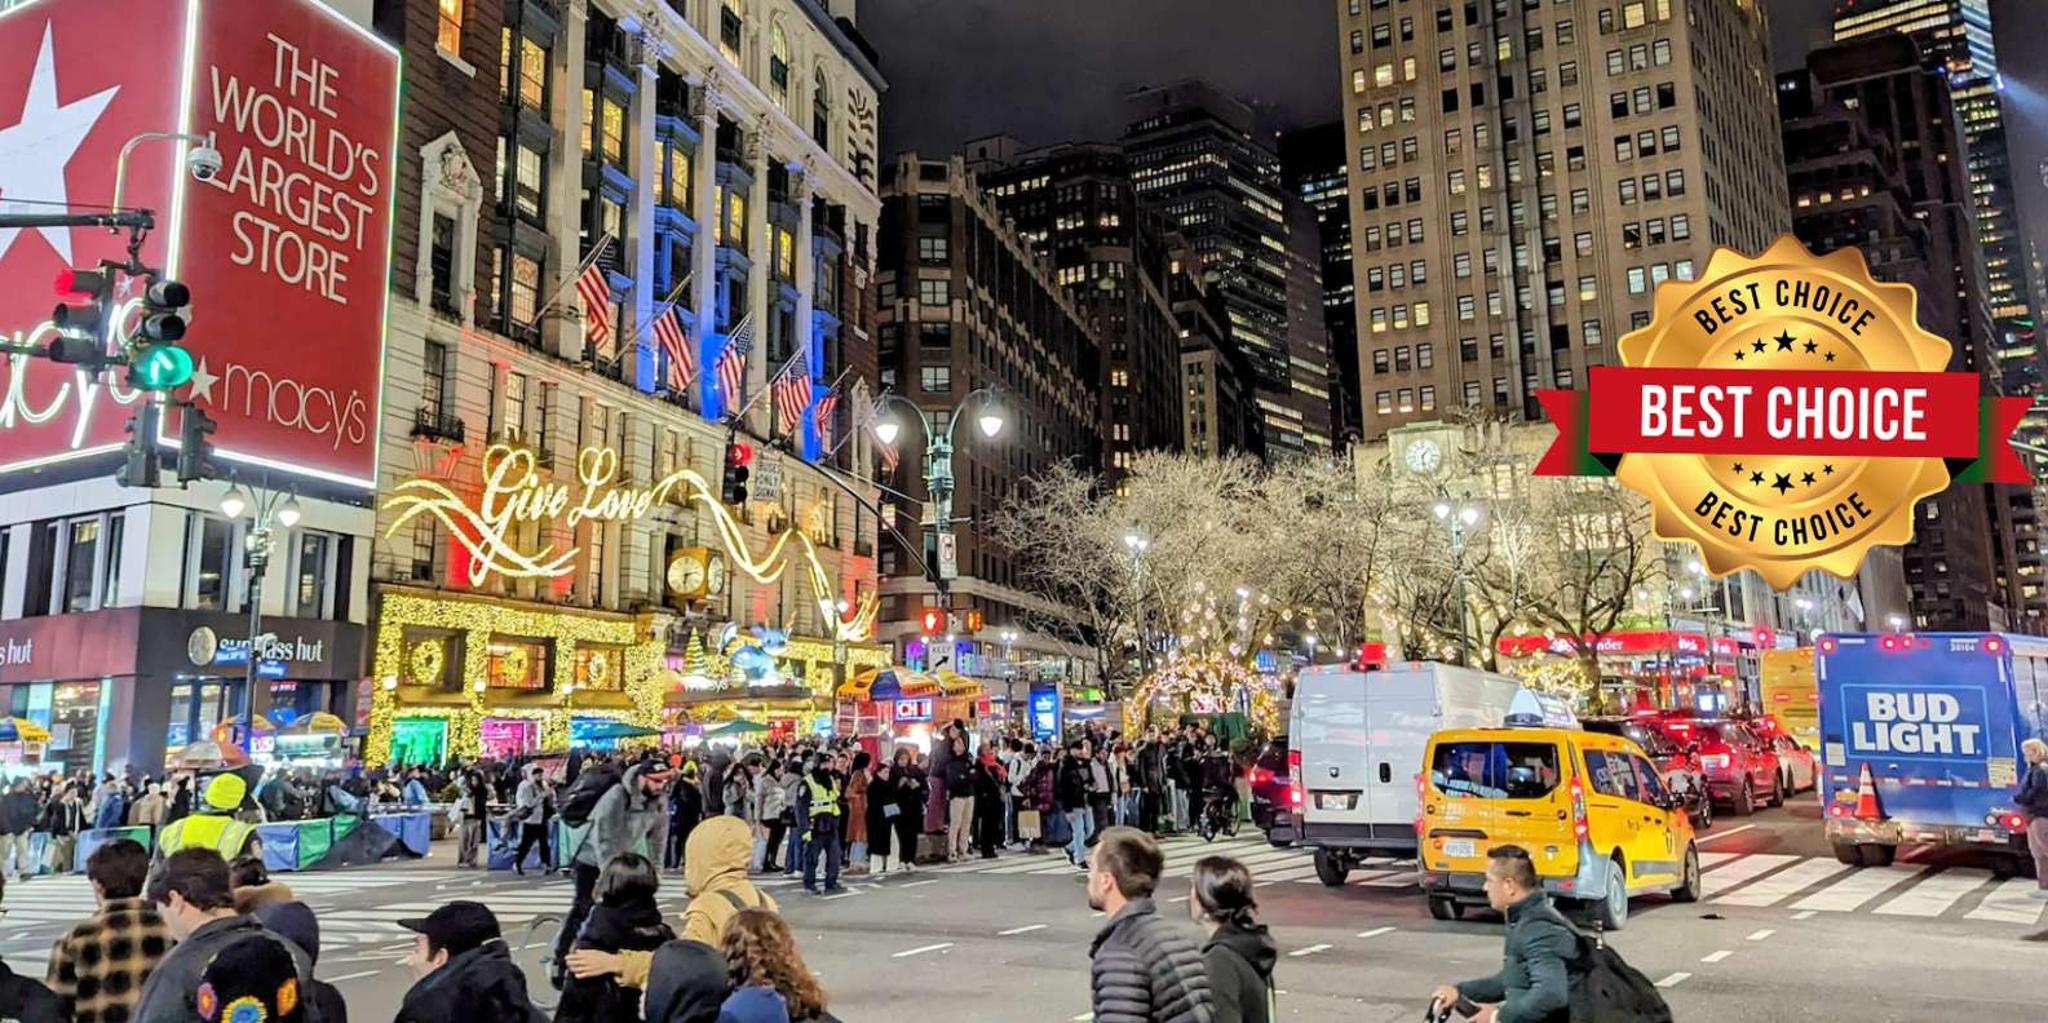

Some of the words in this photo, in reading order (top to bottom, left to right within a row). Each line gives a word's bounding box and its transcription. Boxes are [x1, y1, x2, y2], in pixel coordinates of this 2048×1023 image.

[267, 32, 339, 119] THE
[210, 65, 380, 197] WORLD'S
[230, 210, 349, 305] STORE
[566, 446, 652, 527] Love
[7, 637, 32, 664] hut
[296, 635, 323, 662] hut
[1866, 691, 1961, 723] BUD
[1852, 721, 1981, 755] LIGHT
